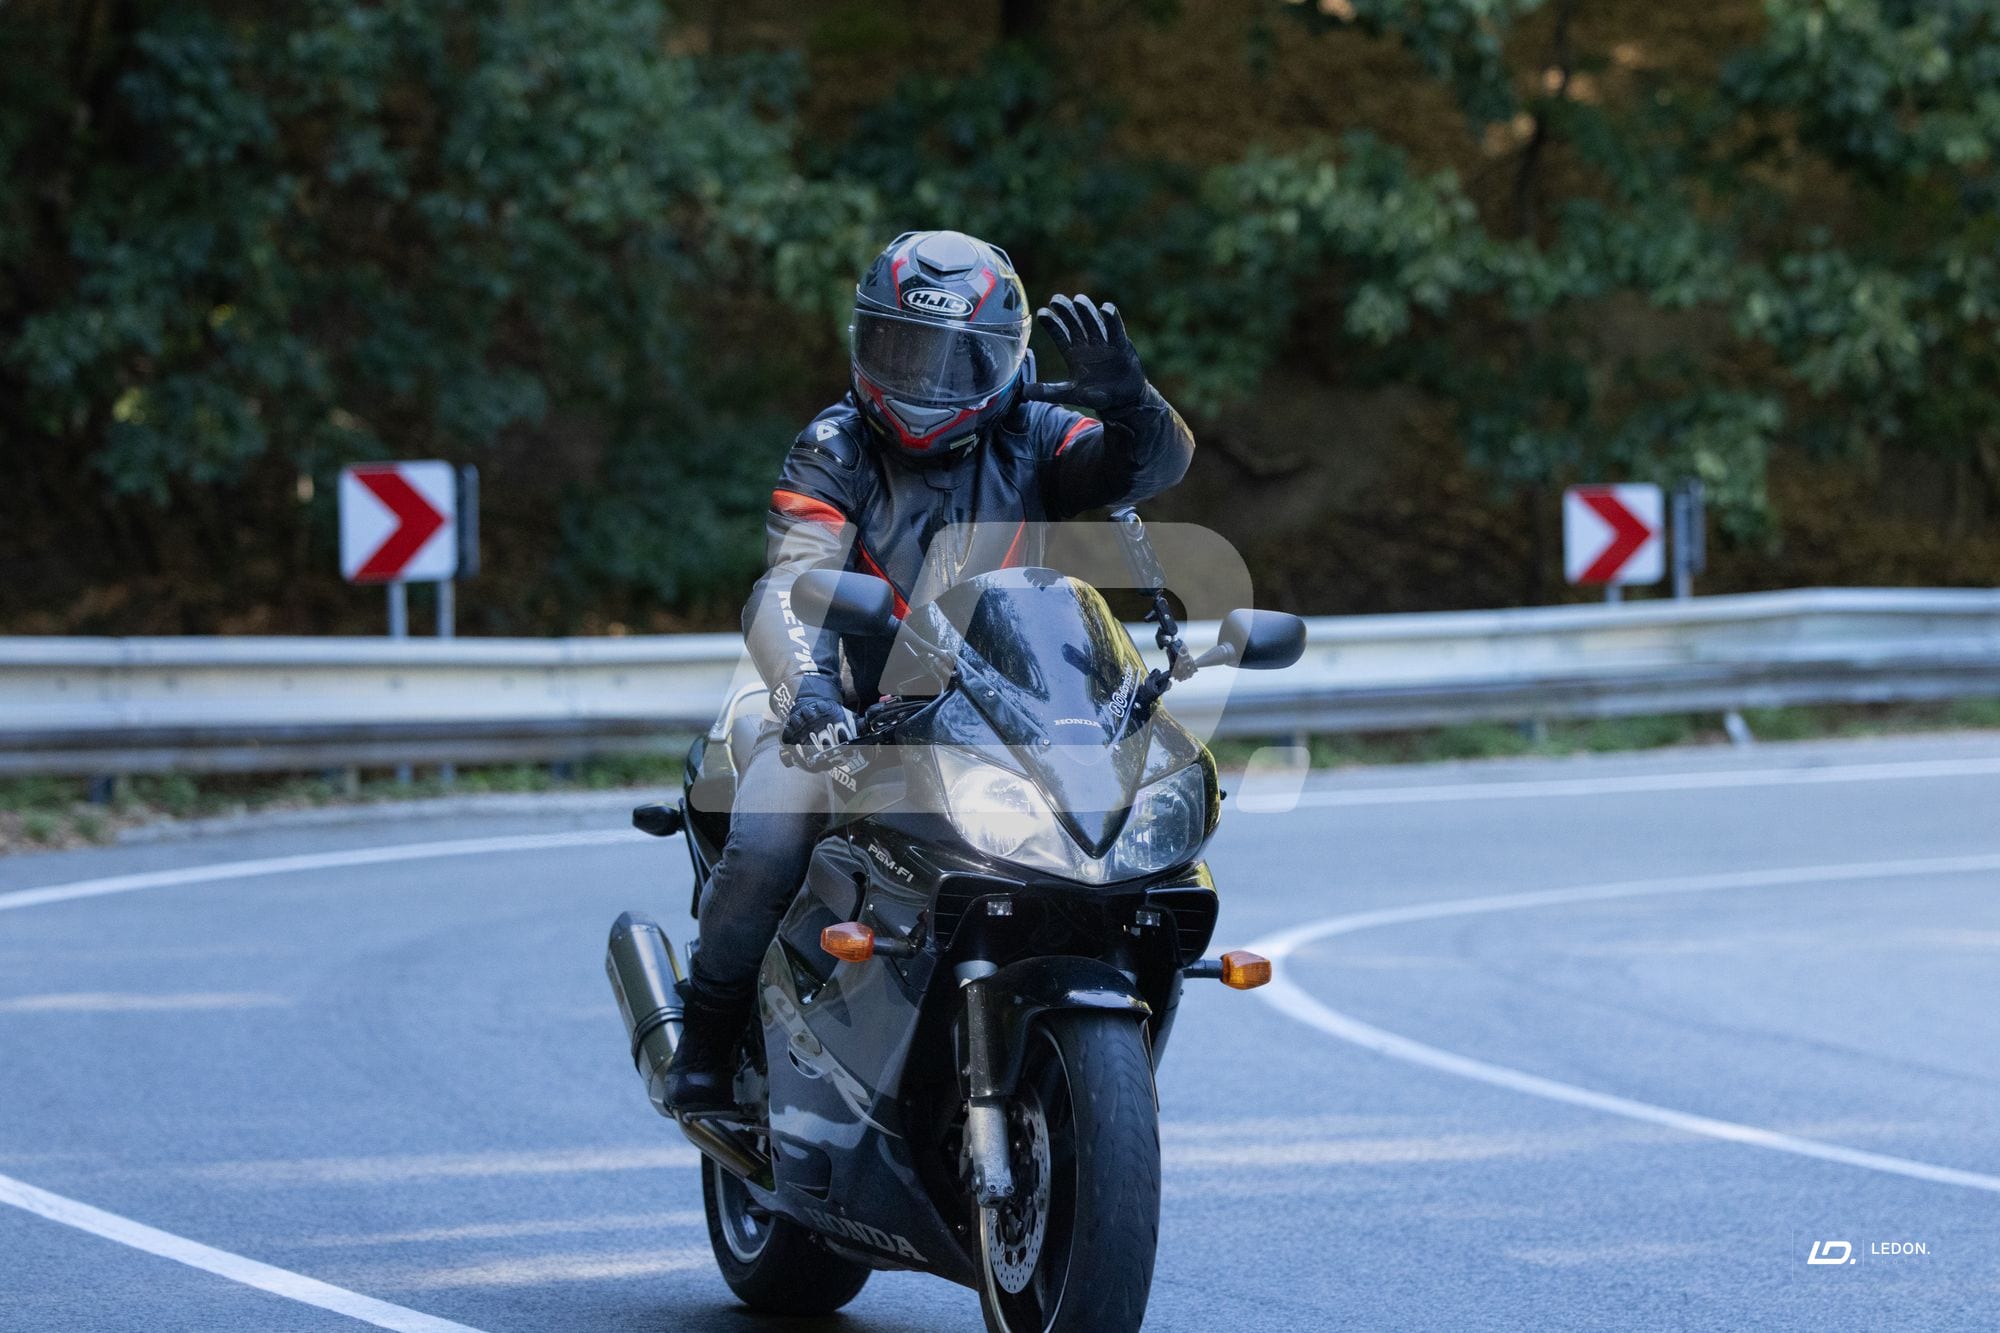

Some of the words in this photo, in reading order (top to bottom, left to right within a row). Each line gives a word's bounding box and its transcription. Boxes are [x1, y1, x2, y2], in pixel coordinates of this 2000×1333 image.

[912, 292, 964, 311] HJC
[1054, 718, 1102, 728] HONDA
[828, 766, 857, 793] NDA
[803, 1206, 929, 1262] HONDA
